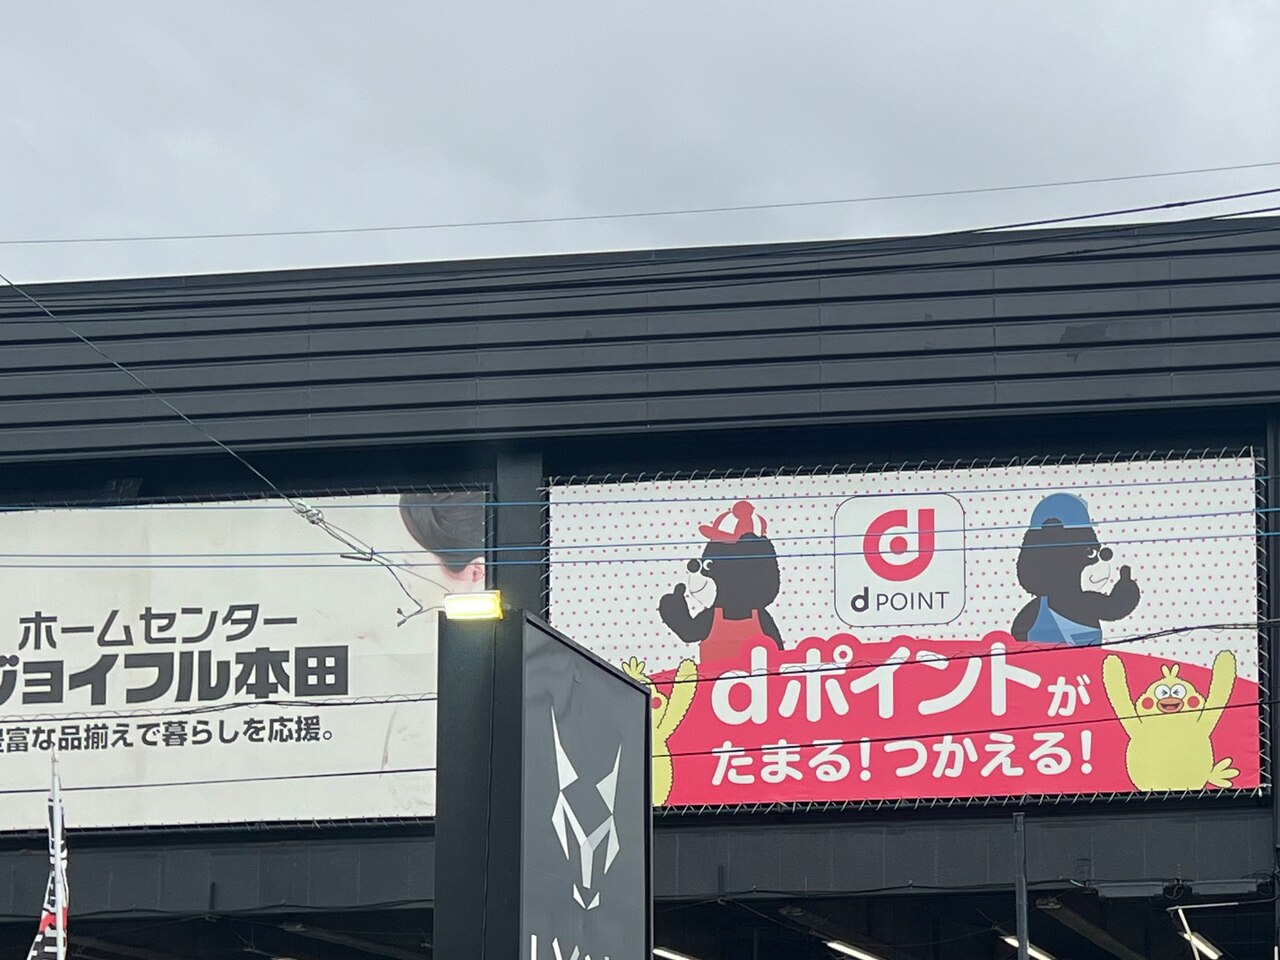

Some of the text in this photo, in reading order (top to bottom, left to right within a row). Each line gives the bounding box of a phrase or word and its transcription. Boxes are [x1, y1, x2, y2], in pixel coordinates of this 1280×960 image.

[851, 586, 950, 613] d POINT
[18, 603, 298, 650] ホームセンター
[711, 642, 1091, 726] dポイントが
[0, 715, 333, 754] 富な品揃えで暮らしを応援。
